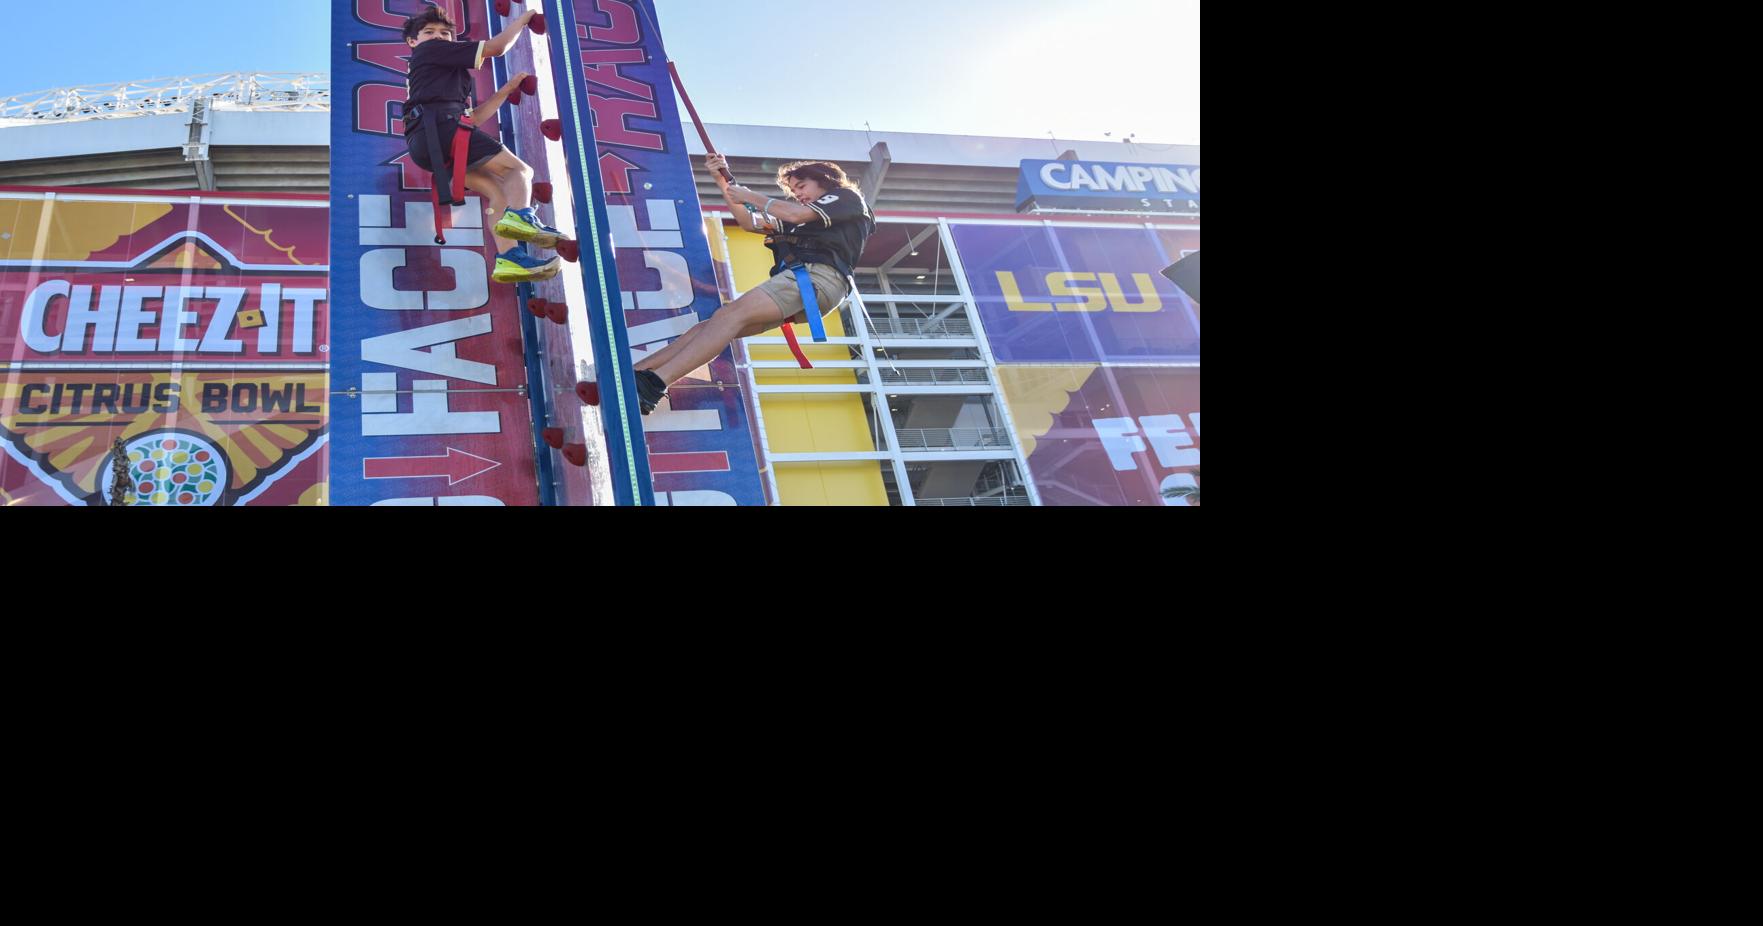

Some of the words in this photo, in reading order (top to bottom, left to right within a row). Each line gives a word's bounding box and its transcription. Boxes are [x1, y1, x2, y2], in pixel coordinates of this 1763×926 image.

[1040, 162, 1200, 194] CAMPIN
[995, 271, 1163, 312] LSU
[358, 194, 501, 436] FACE
[19, 383, 181, 415] CITRUS
[201, 382, 320, 413] BOWL
[1091, 412, 1200, 471] FE
